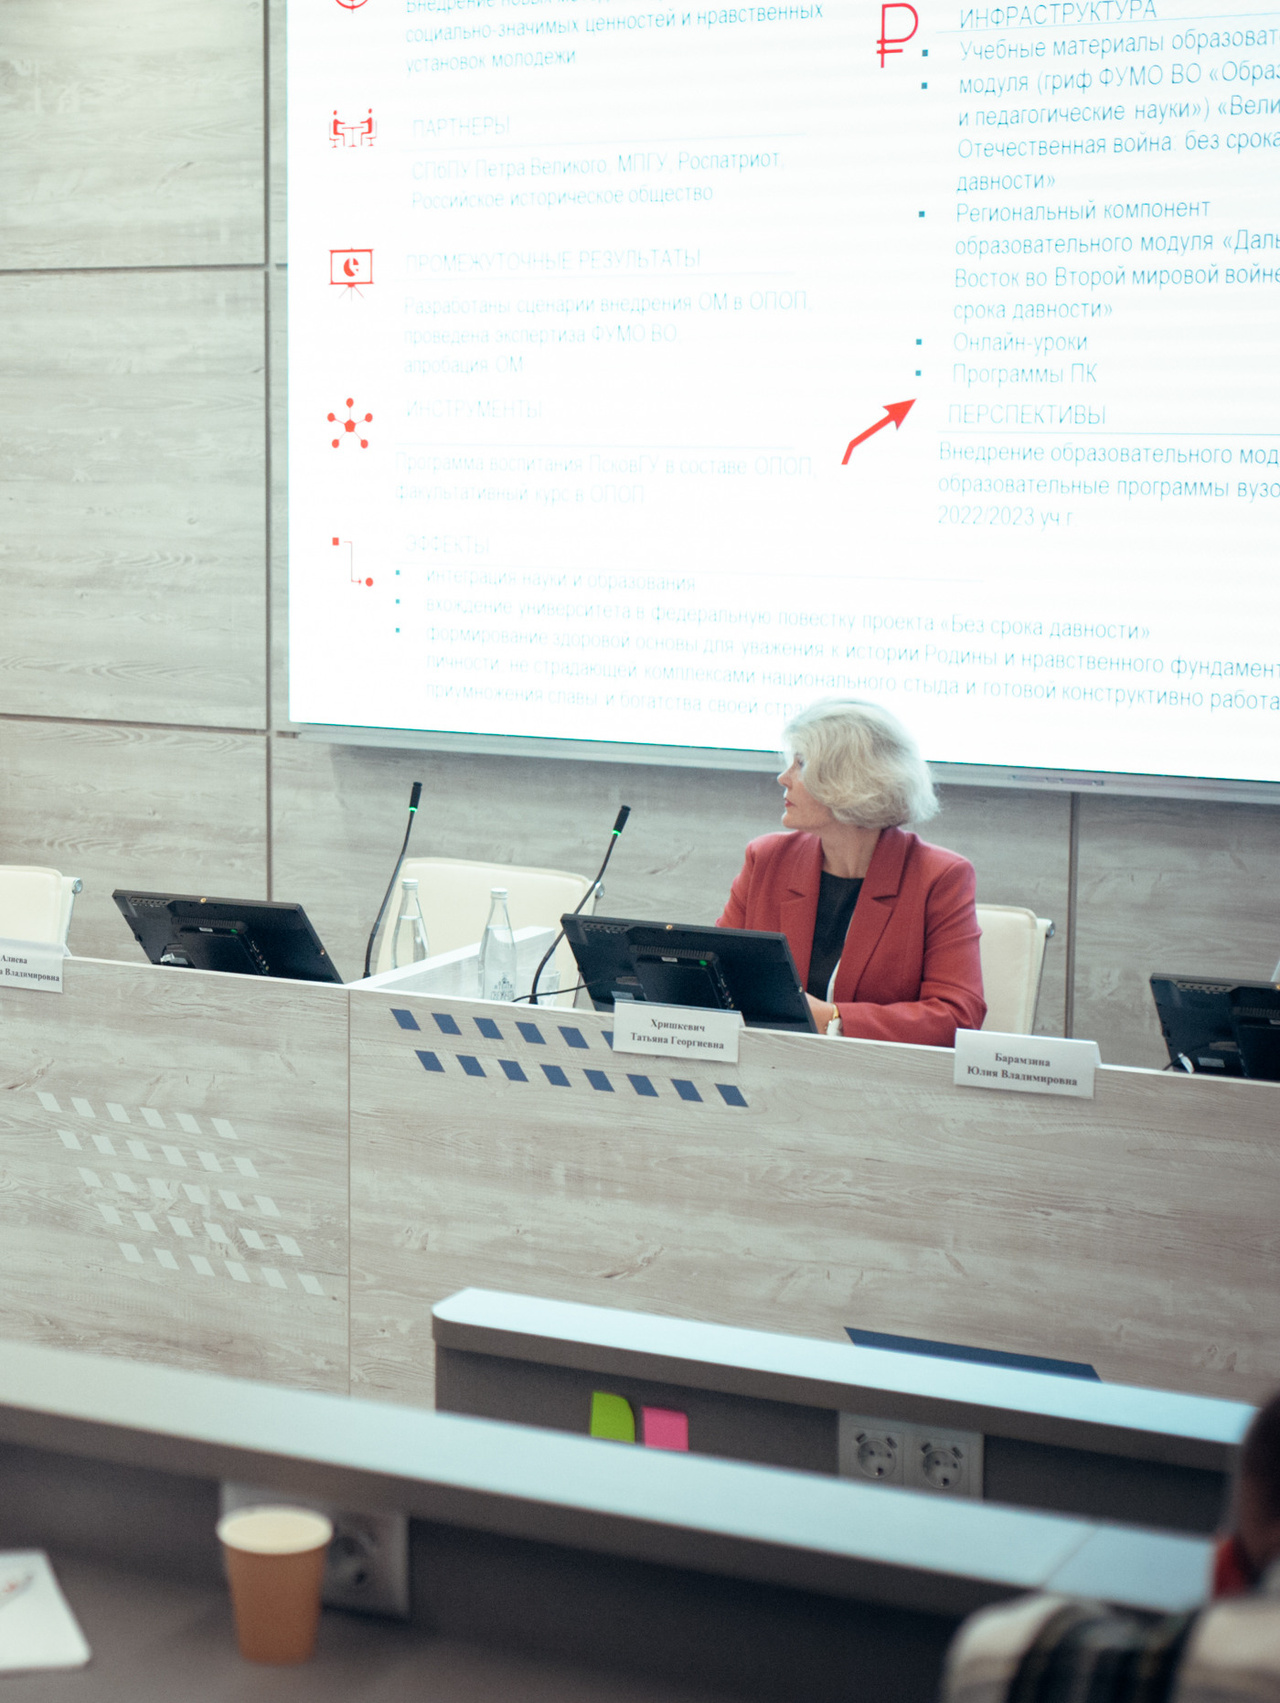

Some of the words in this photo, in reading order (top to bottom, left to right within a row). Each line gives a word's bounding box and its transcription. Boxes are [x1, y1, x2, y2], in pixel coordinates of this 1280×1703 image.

[406, 20, 579, 44] социально-значимых
[586, 9, 675, 34] ценностей
[681, 13, 691, 27] и
[697, 4, 823, 27] нравственных
[960, 0, 1157, 29] ИНФРАСТРУКТУРА
[961, 40, 1046, 61] Учебные
[1053, 35, 1163, 59] материалы
[1172, 28, 1280, 55] образоват
[406, 55, 486, 74] установок
[491, 48, 576, 68] молодежи
[959, 73, 1028, 97] модуля
[1036, 69, 1092, 95] (гриф
[1099, 64, 1163, 87] ФУМО
[1172, 62, 1201, 84] ВО
[959, 112, 969, 126] и
[975, 104, 1125, 128] педагогические
[1135, 96, 1209, 124] науки»)
[412, 115, 511, 139] ПАРТНЕРЫ
[958, 136, 1106, 159] Отечественная
[1185, 129, 1219, 151] без
[1226, 131, 1280, 154] срока
[476, 157, 525, 180] Петра
[956, 171, 1056, 194] давности»
[412, 189, 504, 210] Российское
[510, 188, 623, 209] историческое
[628, 185, 713, 205] общество
[956, 200, 1096, 222] Региональный
[1103, 200, 1211, 219] компонент
[954, 235, 1133, 259] образовательного
[1140, 233, 1213, 256] модуля
[406, 250, 572, 274] ПРОМЕЖУТОЧНЫЕ
[579, 248, 701, 270] РЕЗУЛЬТАТЫ
[954, 267, 1019, 288] Восток
[1026, 271, 1047, 287] во
[1055, 265, 1125, 290] Второй
[1132, 263, 1218, 290] мировой
[403, 296, 510, 317] Разработаны
[517, 296, 595, 315] сценарии
[601, 293, 692, 314] внедрения
[698, 292, 727, 311] ОМ
[733, 296, 742, 310] в
[953, 303, 1005, 323] срока
[1013, 301, 1113, 322] давности»
[403, 329, 489, 347] проведена
[495, 327, 585, 346] экспертиза
[591, 324, 646, 343] ФУМО
[953, 332, 1087, 356] Онлайн-уроки
[403, 355, 488, 376] апробация
[495, 355, 524, 373] ОМ
[953, 363, 1063, 388] Программы
[1071, 362, 1098, 383] ПК
[405, 400, 542, 419] ИНСТРУМЕНТЫ
[947, 403, 1106, 425] ПЕРСПЕКТИВЫ
[394, 451, 484, 474] Программа
[490, 456, 582, 473] воспитания
[589, 455, 659, 474] ПсковГУ
[665, 458, 674, 473] в
[680, 458, 747, 475] составе
[938, 441, 1044, 465] Внедрение
[1050, 442, 1232, 467] образовательного
[395, 483, 528, 504] факультативный
[534, 488, 570, 507] курс
[574, 489, 583, 502] в
[590, 485, 644, 503] ОПОП
[938, 473, 1109, 496] образовательные
[1117, 477, 1229, 501] программы
[937, 504, 1035, 526] 2022/2023
[405, 534, 491, 555] ЭФФЕКТЫ
[426, 567, 516, 586] интеграция
[522, 571, 567, 588] науки
[573, 573, 582, 587] и
[587, 571, 695, 593] образования
[426, 595, 513, 615] вхождение
[518, 599, 631, 622] университета
[636, 605, 645, 620] в
[652, 602, 771, 627] федеральную
[778, 608, 854, 631] повестку
[862, 613, 934, 637] проекта
[941, 612, 984, 632] «Без
[990, 618, 1043, 639] срока
[1049, 620, 1150, 642] давности»
[426, 625, 548, 647] формирование
[553, 628, 630, 652] здоровой
[636, 636, 697, 653] основы
[703, 636, 734, 655] для
[740, 639, 824, 660] уважения
[831, 644, 840, 659] к
[845, 644, 920, 667] истории
[925, 642, 997, 668] Родины
[1005, 650, 1015, 667] и
[1021, 650, 1164, 677] нравственного
[510, 659, 529, 673] не
[534, 659, 637, 679] страдающей
[644, 665, 755, 684] комплексами
[762, 669, 896, 692] национального
[904, 676, 959, 695] стыда
[966, 680, 976, 695] и
[983, 675, 1056, 699] готовой
[1062, 682, 1204, 708] конструктивно
[620, 690, 701, 711] богатства
[709, 697, 758, 713] своей
[765, 701, 803, 717] стра
[0, 955, 28, 964] Алиева
[5, 968, 60, 982] Владимировна
[650, 1018, 705, 1032] Хришкевич
[630, 1032, 669, 1044] Татьяна
[671, 1036, 724, 1049] Георгиевна
[995, 1053, 1050, 1067] Барамзина
[967, 1065, 998, 1078] Юлия
[1001, 1069, 1077, 1086] Владимировна
